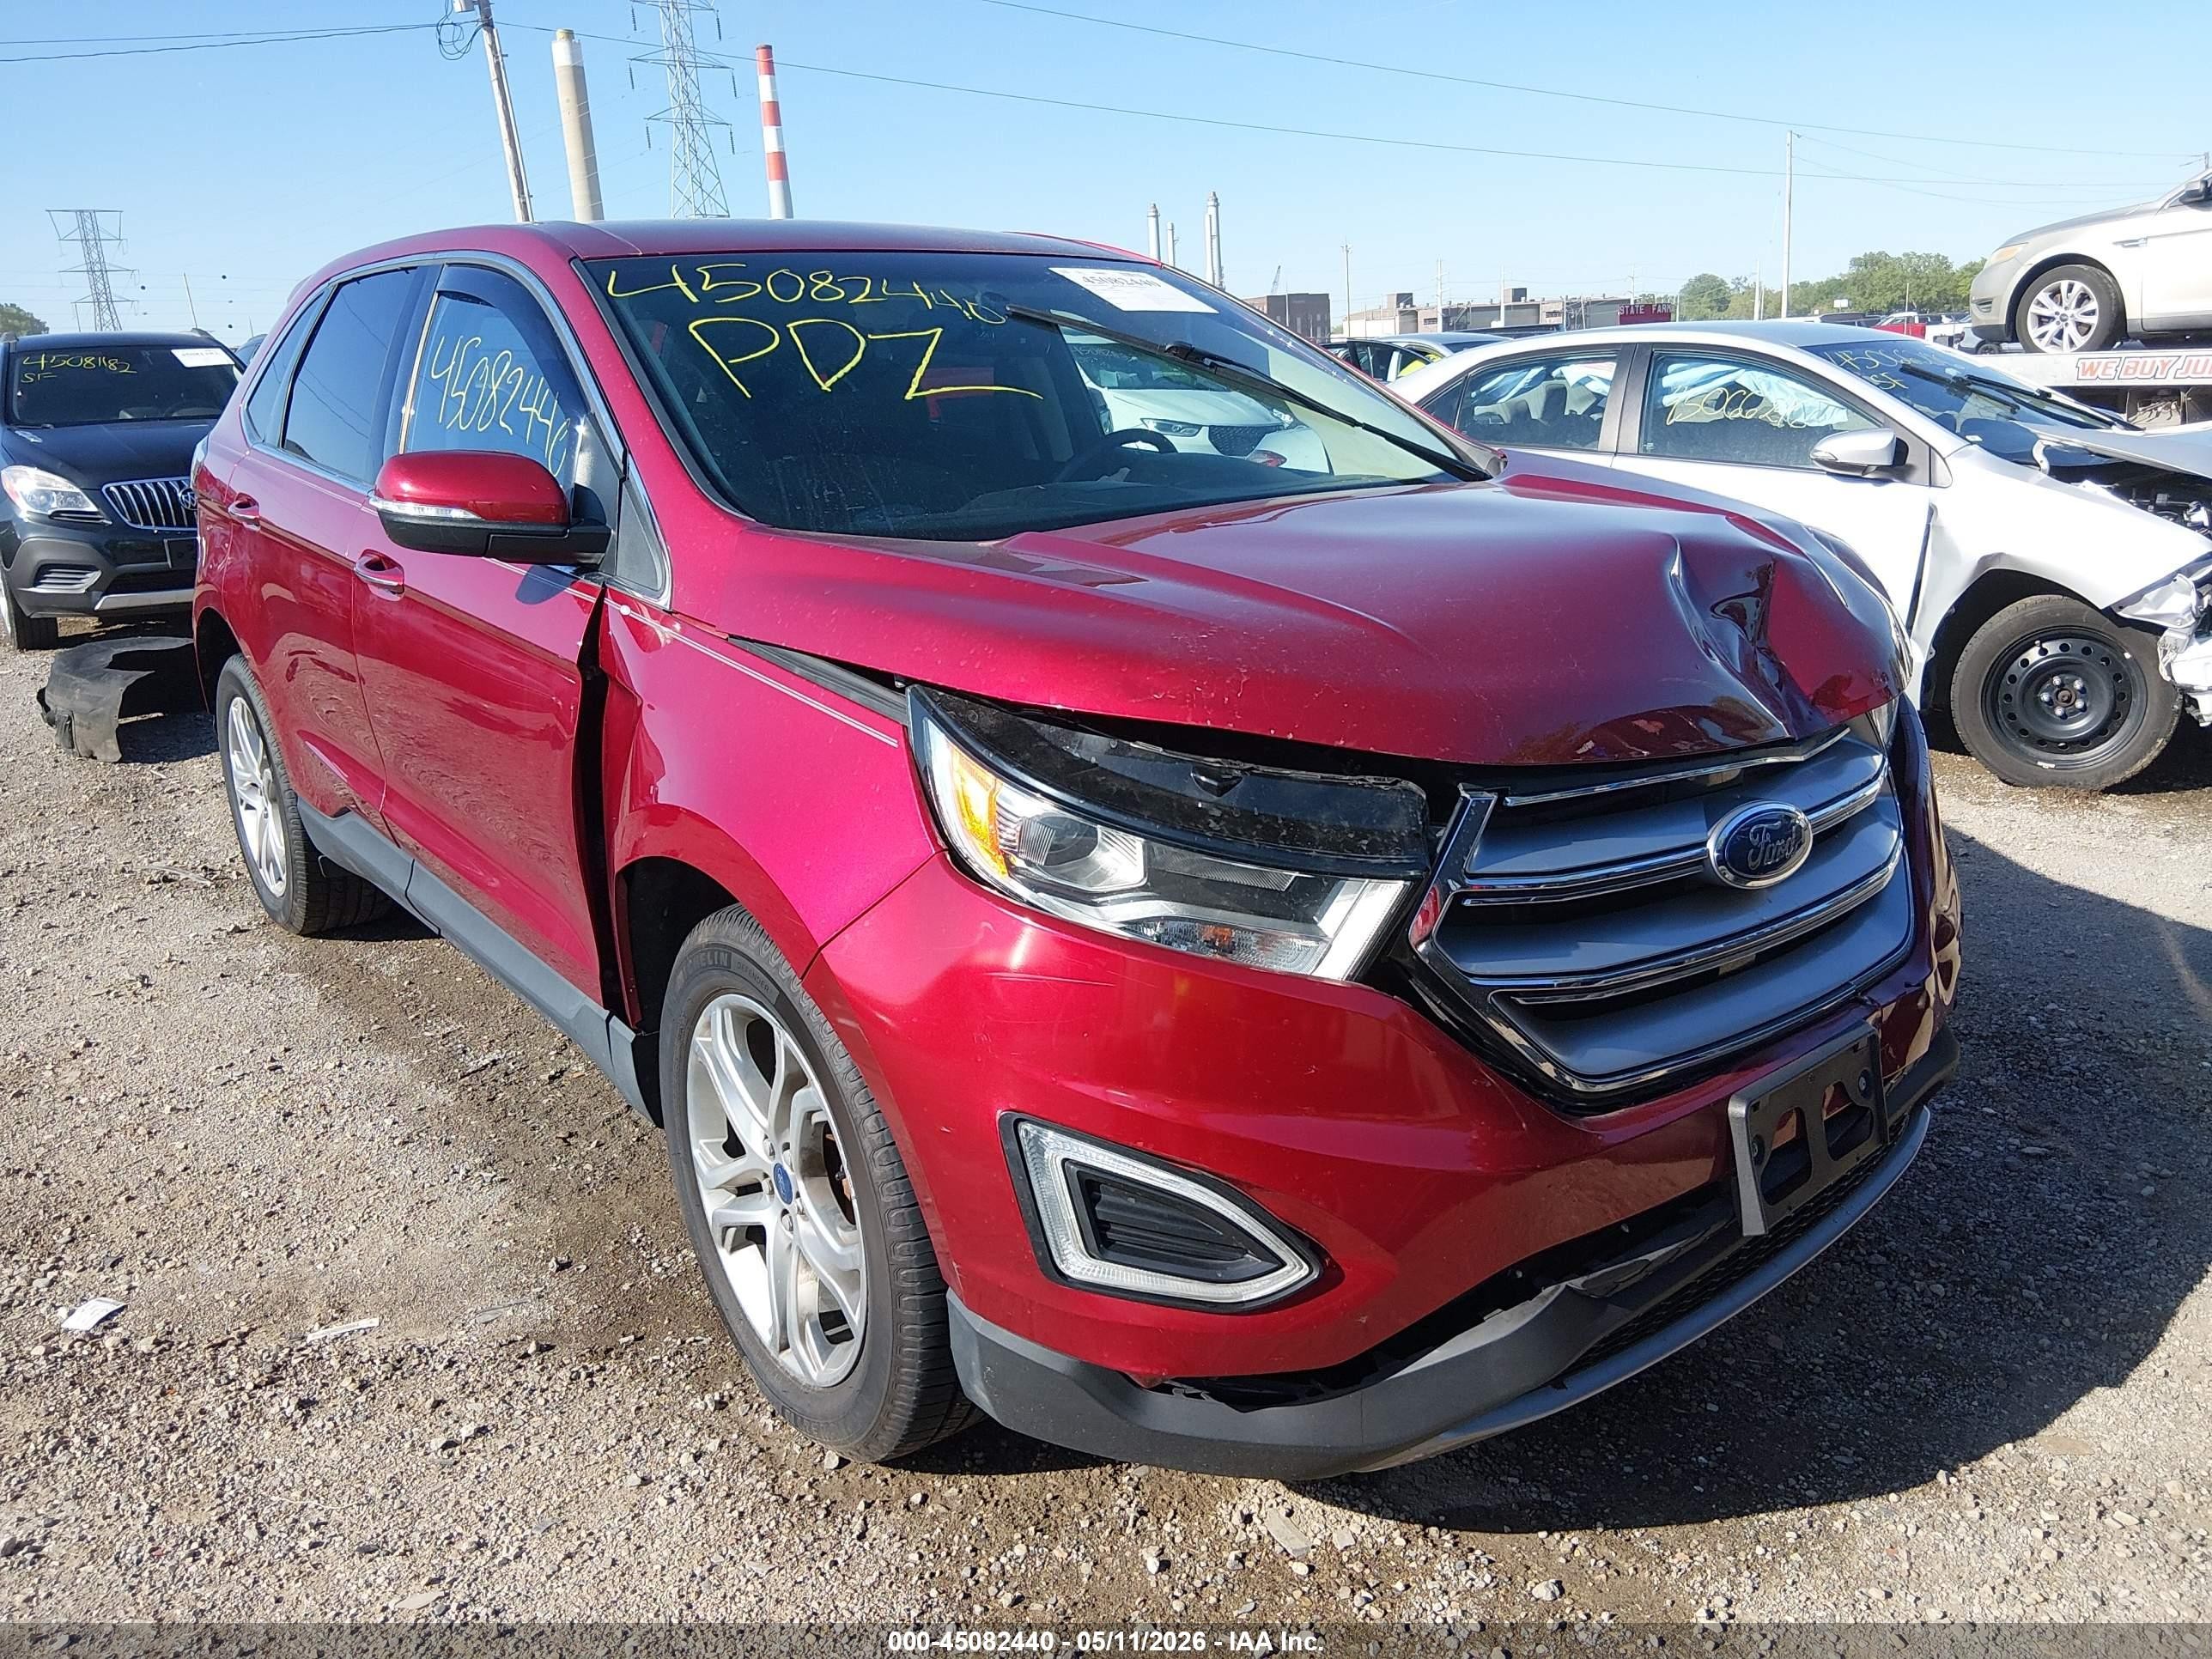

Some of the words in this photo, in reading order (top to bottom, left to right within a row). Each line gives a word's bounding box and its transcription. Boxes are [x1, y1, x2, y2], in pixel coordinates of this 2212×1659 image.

[1620, 305, 1645, 315] STATE
[1652, 303, 1672, 314] FARM
[22, 353, 137, 374] 45081182
[688, 317, 1044, 401] PDZ
[2078, 359, 2120, 379] WE
[2120, 357, 2178, 378] BUY
[2177, 356, 2212, 378] JU
[1747, 820, 1803, 871] Ford
